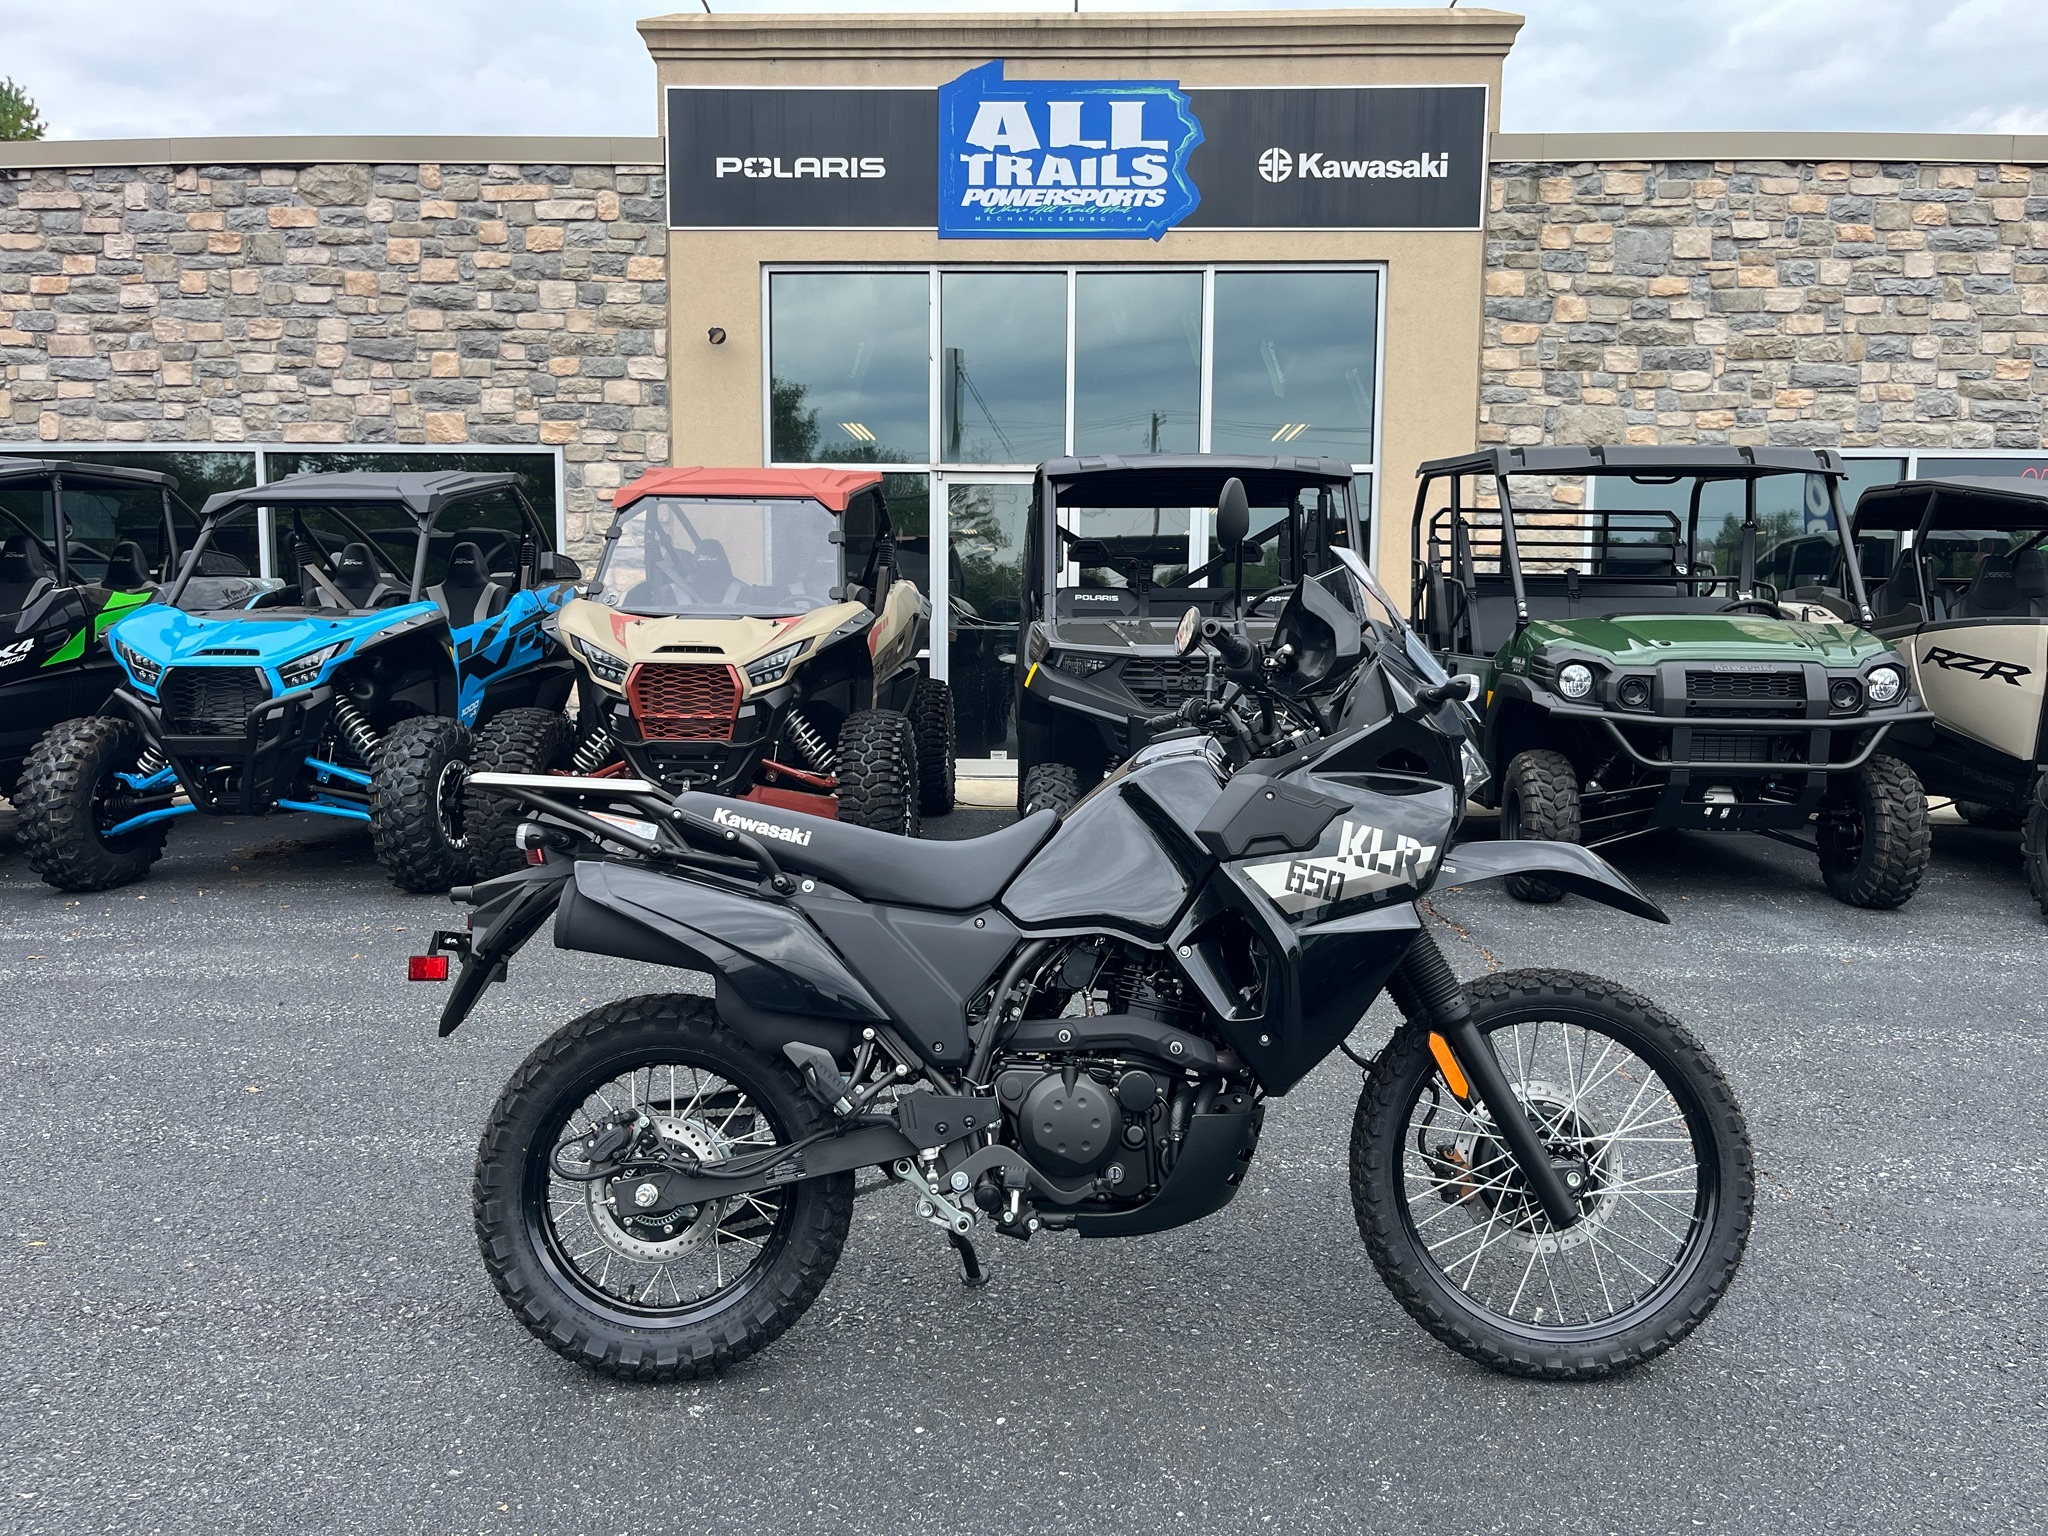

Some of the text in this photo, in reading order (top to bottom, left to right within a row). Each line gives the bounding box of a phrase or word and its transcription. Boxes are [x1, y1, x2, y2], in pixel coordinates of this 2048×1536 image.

[966, 101, 1168, 153] ALL
[716, 157, 886, 178] POLARIS
[960, 153, 1168, 187] TRAILS
[1298, 152, 1449, 178] Kawasaki
[961, 188, 1167, 207] POWERSPORTS
[1074, 594, 1119, 602] POLARIS
[1713, 663, 1774, 671] Kawasaki
[1921, 646, 2032, 687] RZR
[1962, 767, 2015, 793] POLARIS
[713, 807, 812, 847] Kawasaki
[1337, 820, 1421, 890] KLR
[1285, 860, 1346, 902] 650
